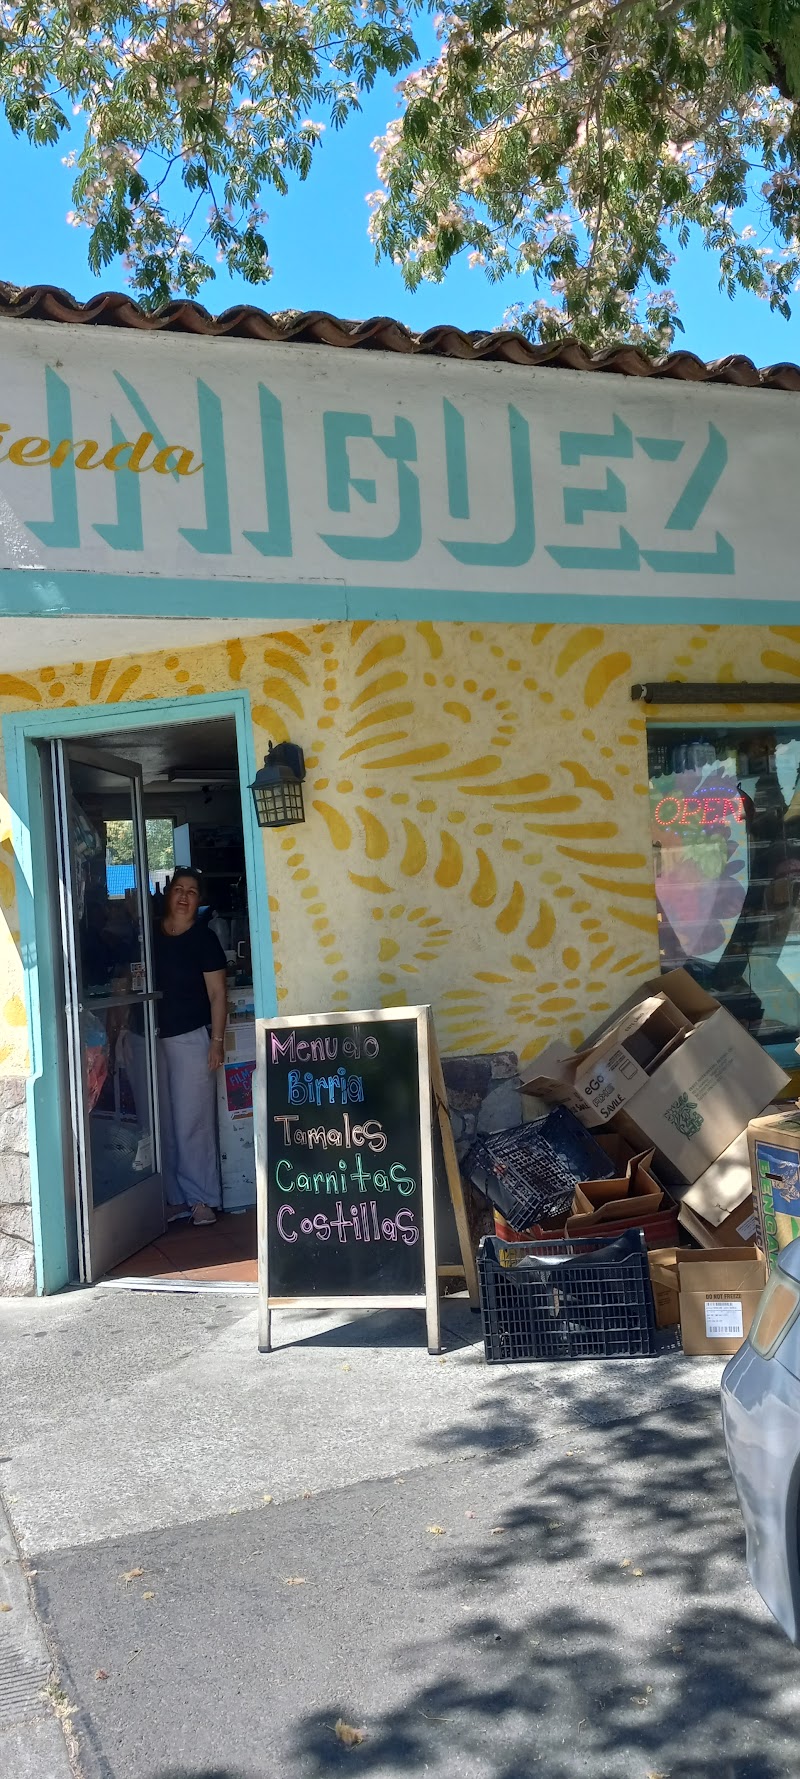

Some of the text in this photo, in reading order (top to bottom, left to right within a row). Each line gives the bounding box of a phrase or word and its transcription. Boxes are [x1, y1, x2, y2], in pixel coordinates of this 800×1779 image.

[655, 797, 744, 825] OPEN
[270, 1025, 379, 1064] Menudo
[288, 1066, 365, 1105] Birria
[584, 1075, 605, 1095] eGo
[600, 1094, 625, 1119] SAVILE
[273, 1113, 388, 1152] Tamales
[276, 1153, 416, 1196] Carnitas
[277, 1201, 419, 1245] Costillas
